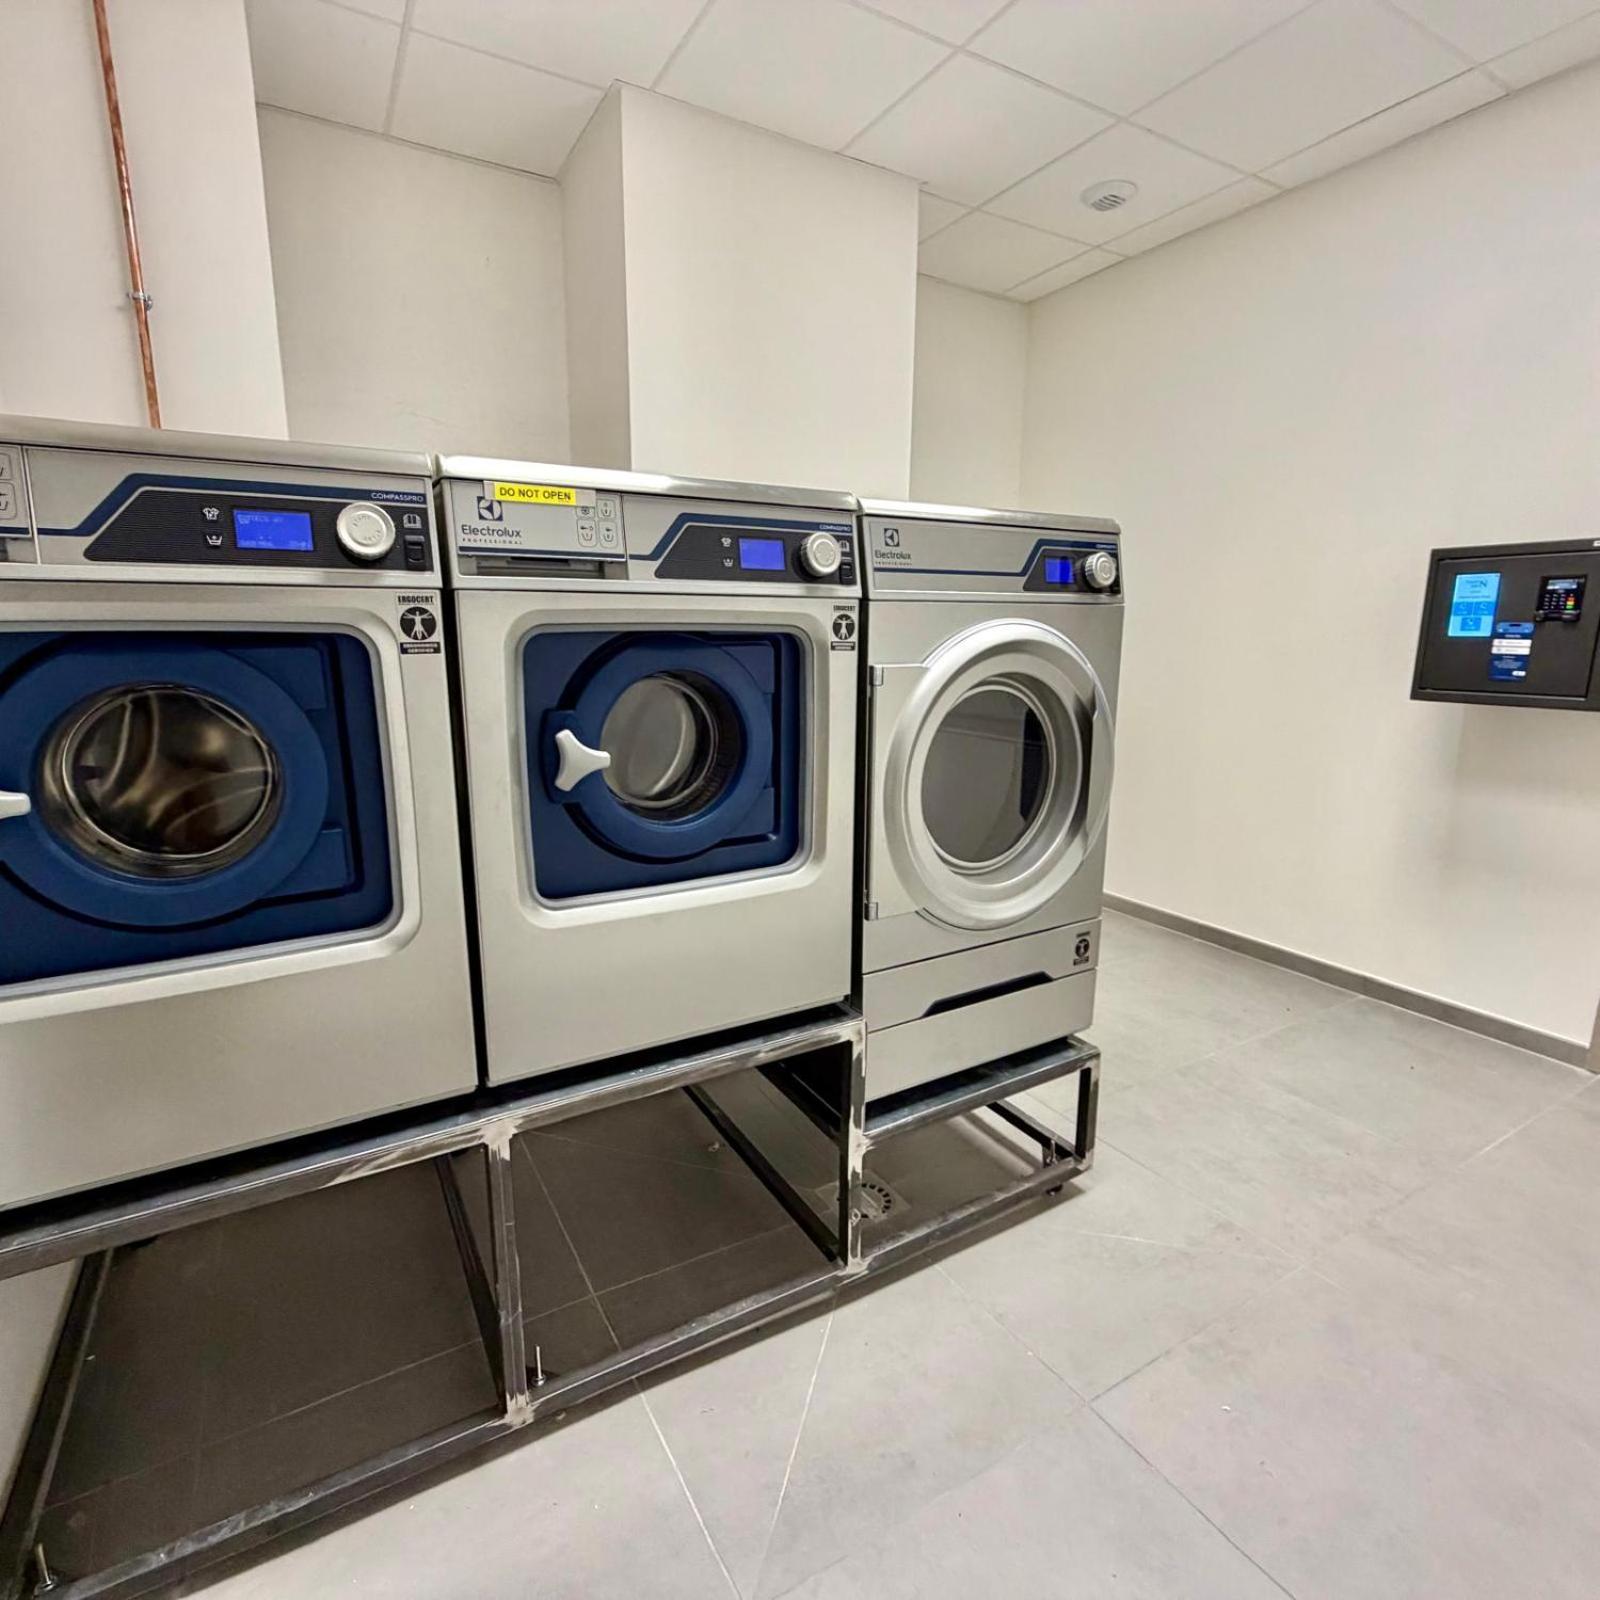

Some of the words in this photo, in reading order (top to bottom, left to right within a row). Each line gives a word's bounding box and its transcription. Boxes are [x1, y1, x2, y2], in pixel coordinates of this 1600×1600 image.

[371, 492, 424, 502] COMPASSPRO
[499, 487, 515, 497] DO
[518, 488, 539, 498] NOT
[543, 490, 571, 500] OPEN
[461, 524, 522, 538] Electrolux
[875, 549, 911, 560] Electrolux
[397, 595, 434, 604] ERGOCERT
